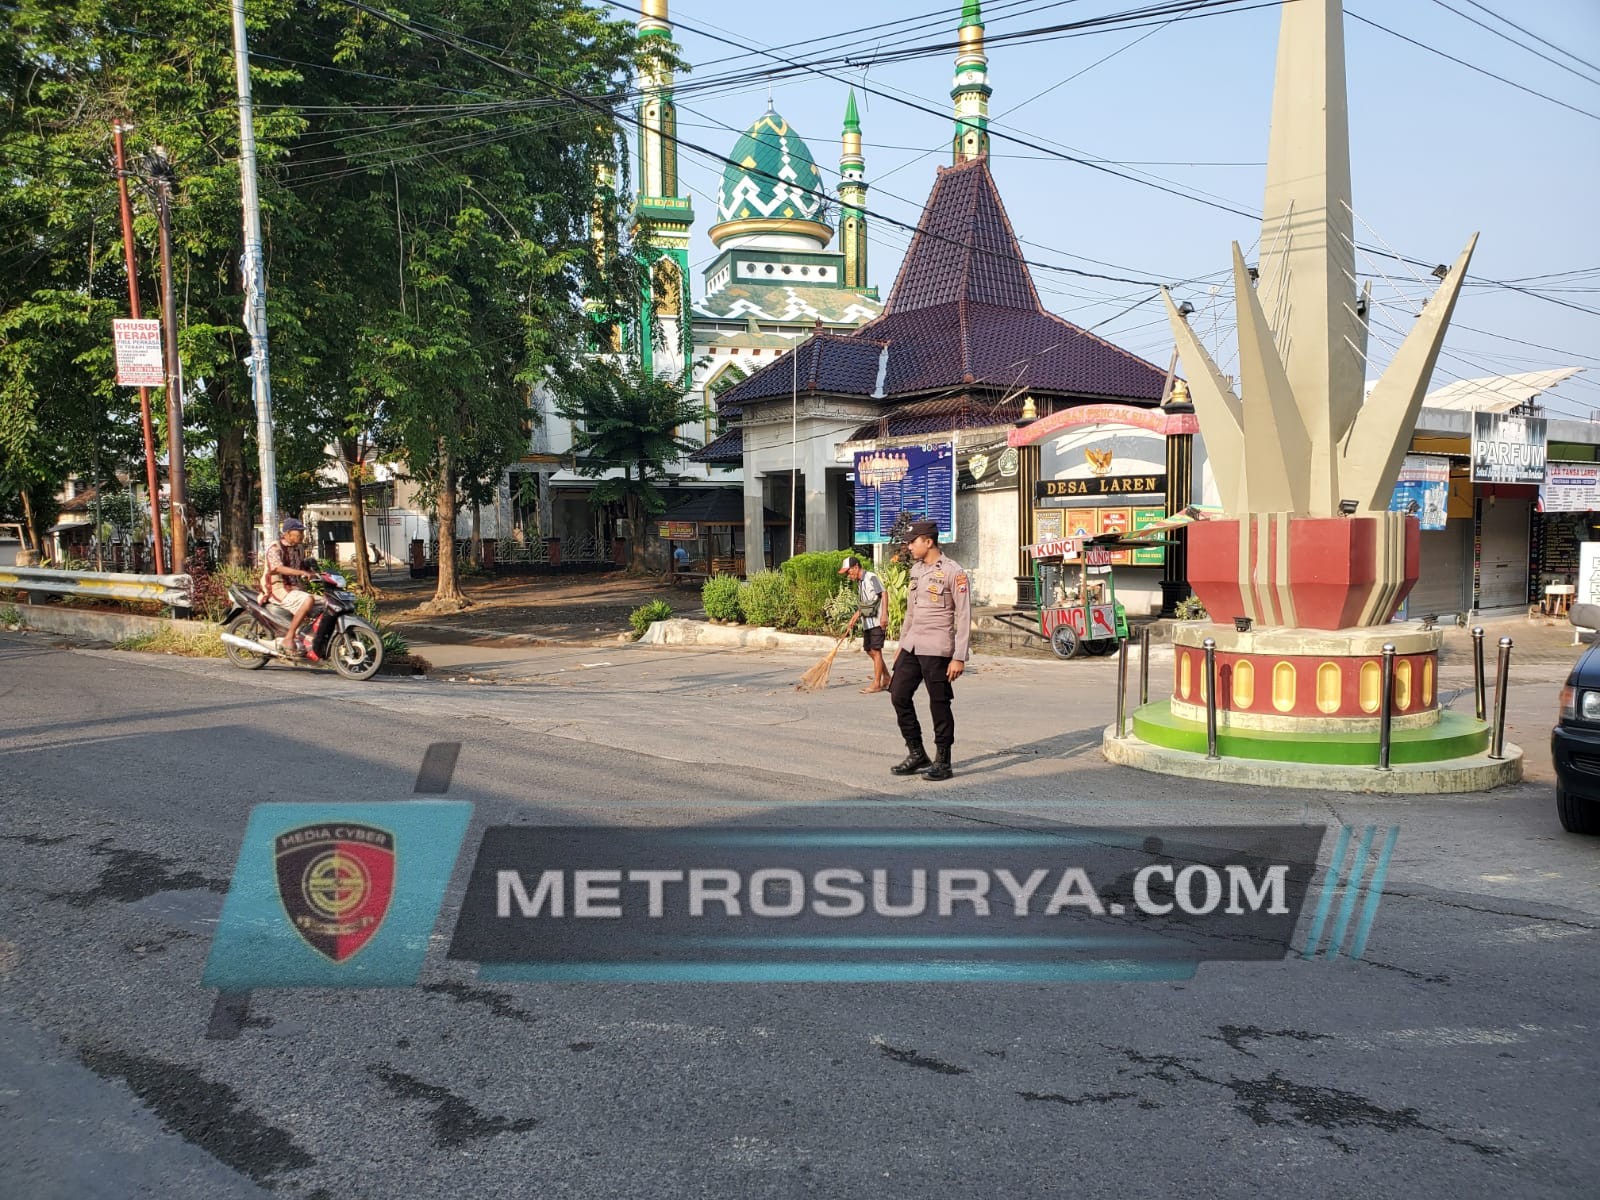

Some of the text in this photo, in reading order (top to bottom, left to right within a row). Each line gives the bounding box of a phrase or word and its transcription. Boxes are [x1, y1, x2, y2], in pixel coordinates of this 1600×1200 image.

[117, 332, 160, 340] TERAPI
[1477, 440, 1544, 467] PARFUM
[1047, 477, 1157, 495] DESA LAREN
[1037, 540, 1075, 557] KUNCI
[1086, 550, 1111, 565] KUNCI
[929, 577, 945, 585] POLRI
